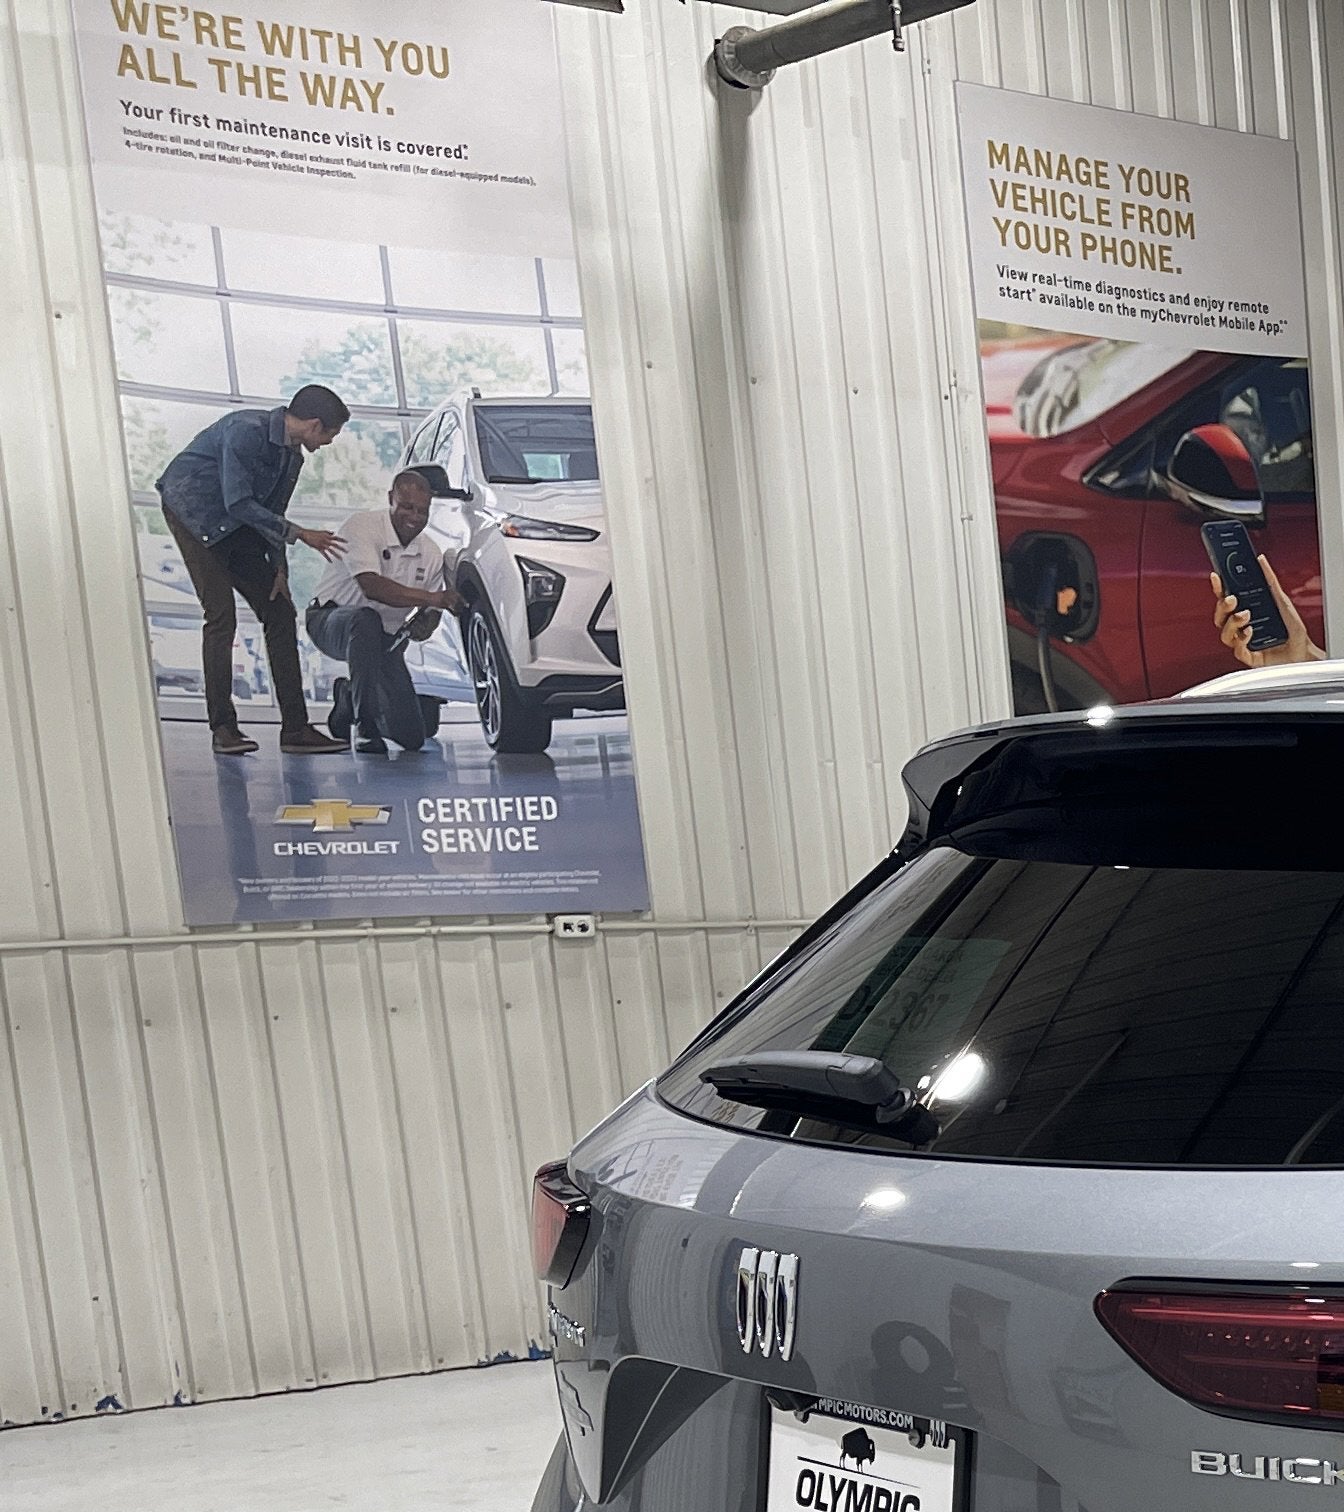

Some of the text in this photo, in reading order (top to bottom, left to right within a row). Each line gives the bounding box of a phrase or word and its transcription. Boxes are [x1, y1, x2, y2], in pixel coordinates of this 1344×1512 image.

[256, 20, 364, 69] WITH
[373, 36, 451, 80] YOU
[117, 43, 396, 116] ALL THE WAY.
[120, 98, 164, 123] Your
[169, 106, 211, 131] first
[216, 116, 331, 148] maintenance
[335, 131, 373, 152] visit
[377, 134, 392, 154] is
[986, 138, 1191, 203] MANAGE YOUR
[988, 177, 1196, 240] VEHICLE FROM
[992, 216, 1183, 275] YOUR PHONE.
[996, 263, 1270, 316] View real-time diagnostics and enjoy remote
[1039, 290, 1095, 312] available
[1098, 301, 1114, 314] on
[1116, 302, 1137, 318] the
[1140, 307, 1216, 329] myChevrolet
[1218, 314, 1255, 332] Mobile
[417, 795, 558, 824] CERTIFIED
[273, 840, 400, 857] CHEVROLET
[421, 826, 539, 854] SERVICE
[813, 1397, 914, 1429] MPICMOTORS.COM
